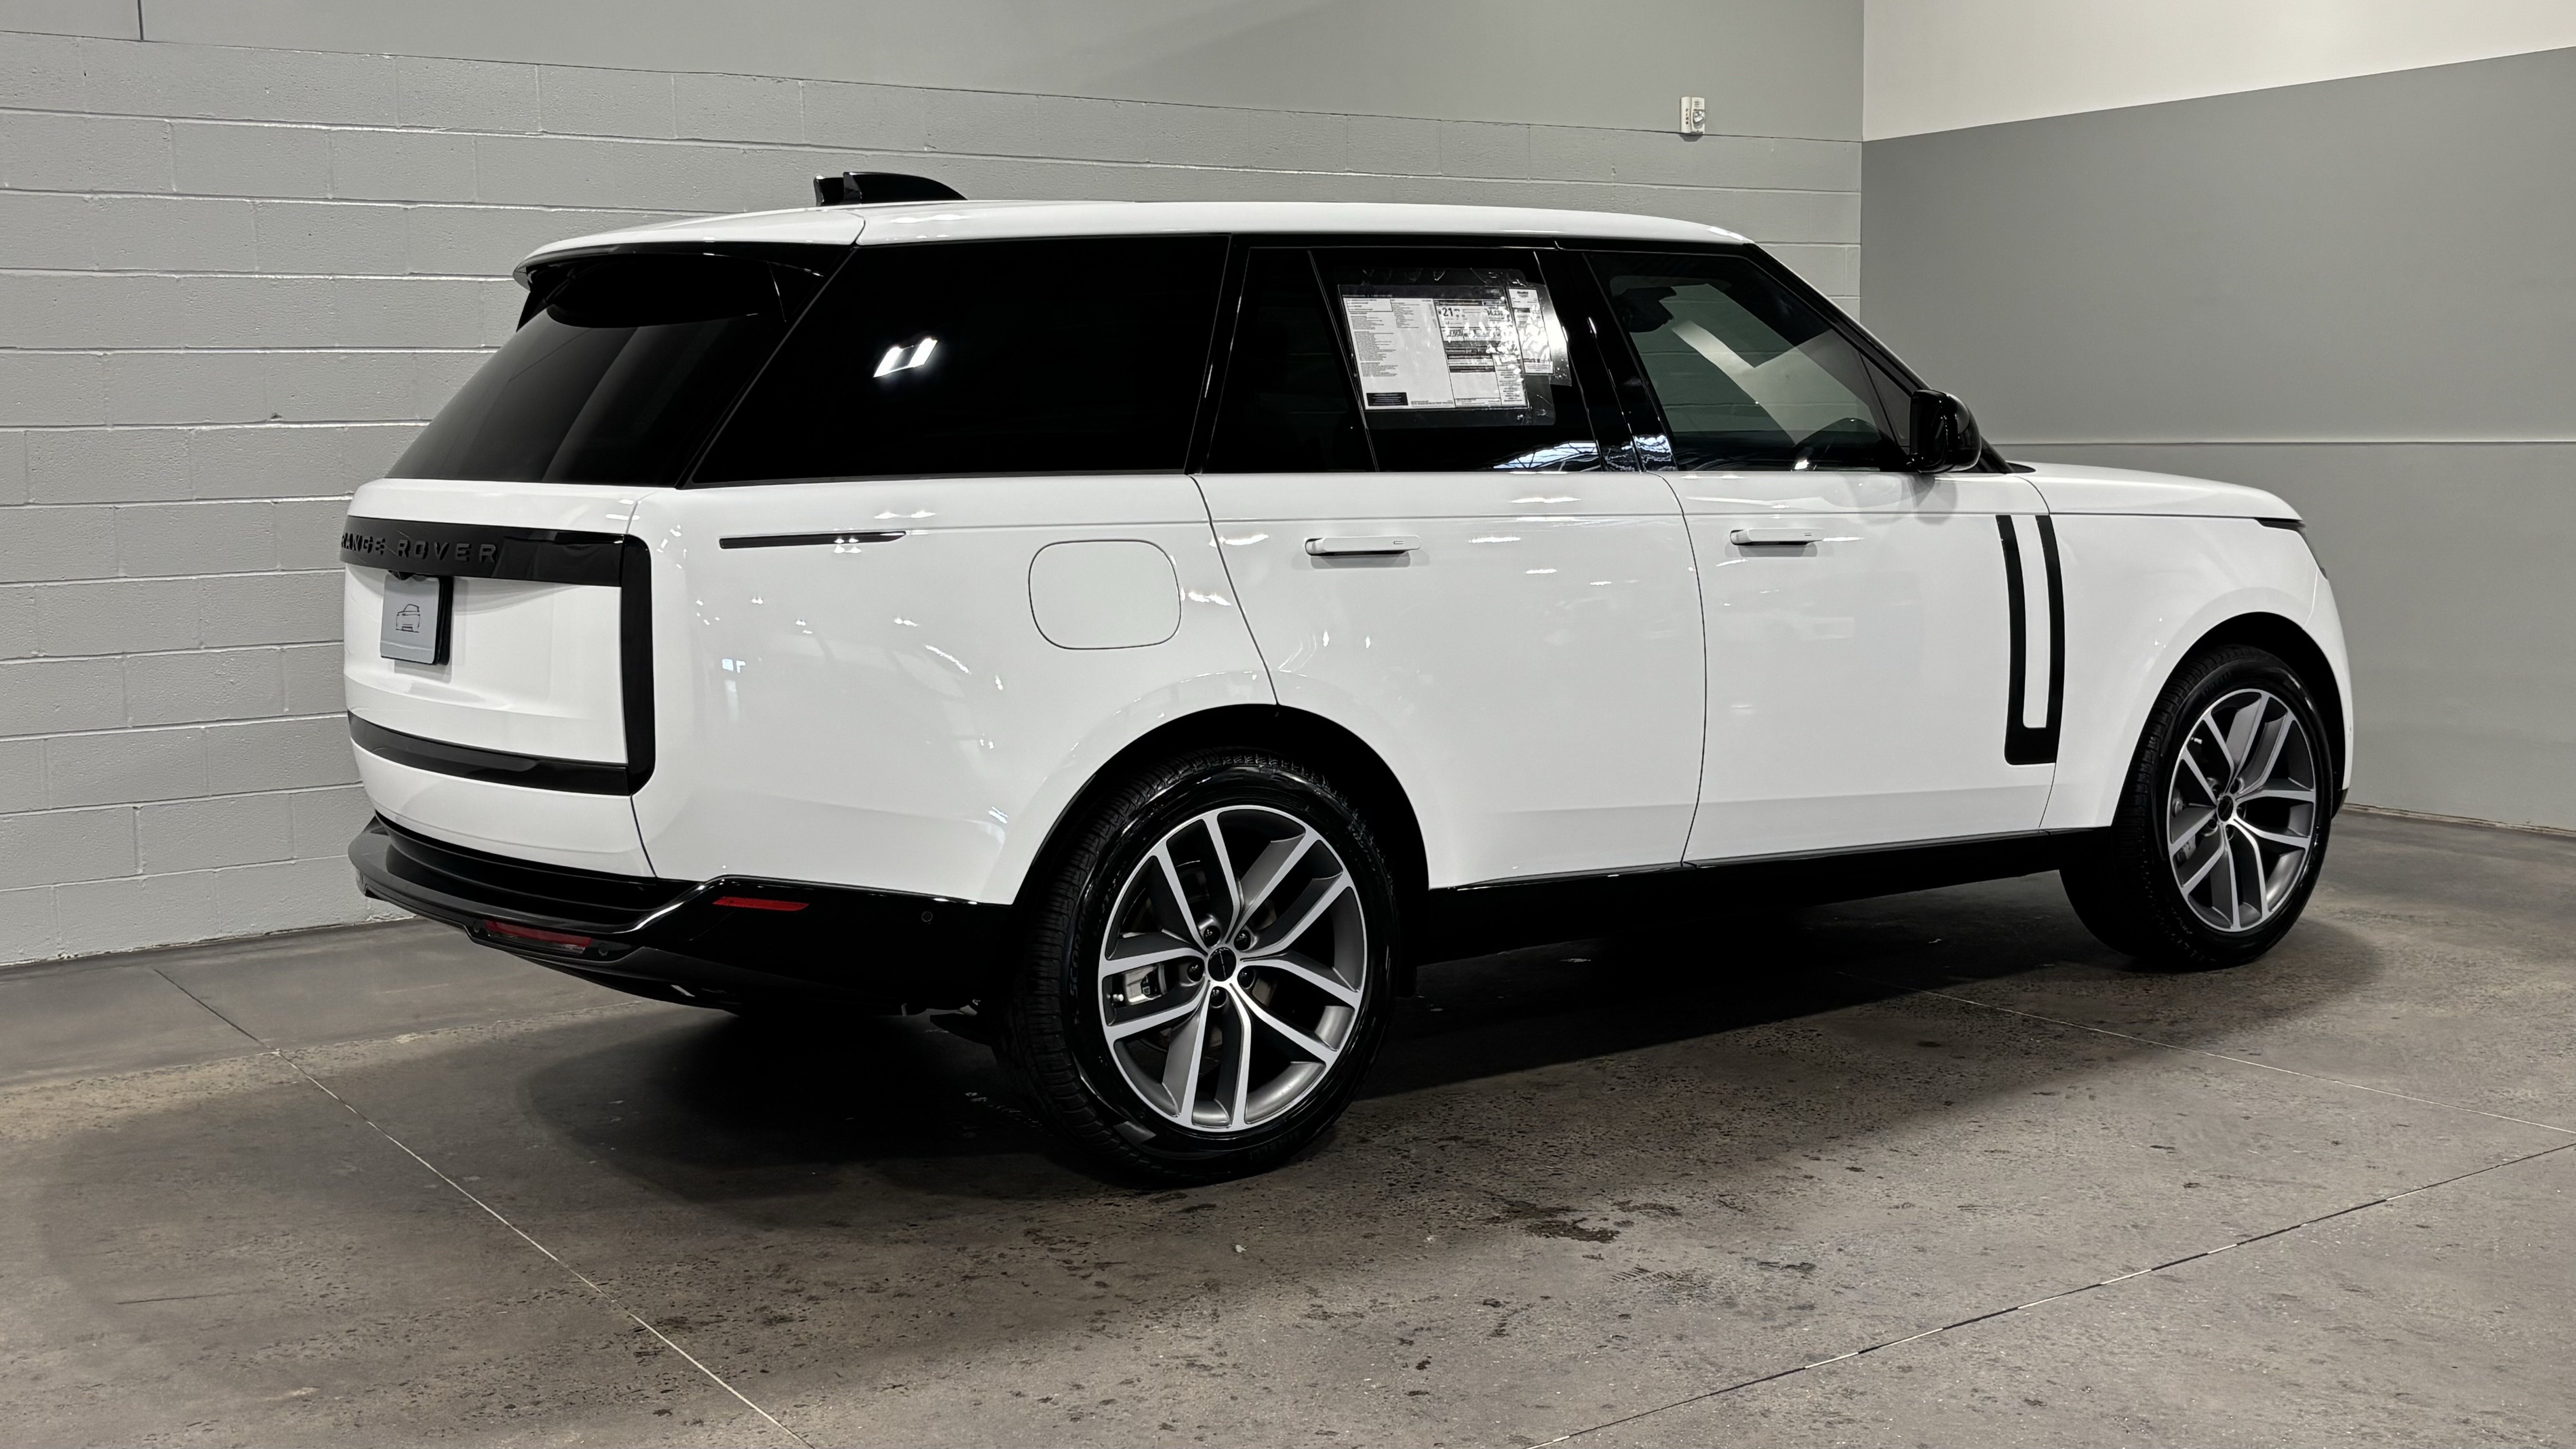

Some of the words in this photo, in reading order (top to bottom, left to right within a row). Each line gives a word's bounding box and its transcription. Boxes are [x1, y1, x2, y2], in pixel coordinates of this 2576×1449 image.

[1442, 308, 1453, 317] 21
[341, 532, 386, 556] RANGE
[397, 539, 498, 563] ROVER
